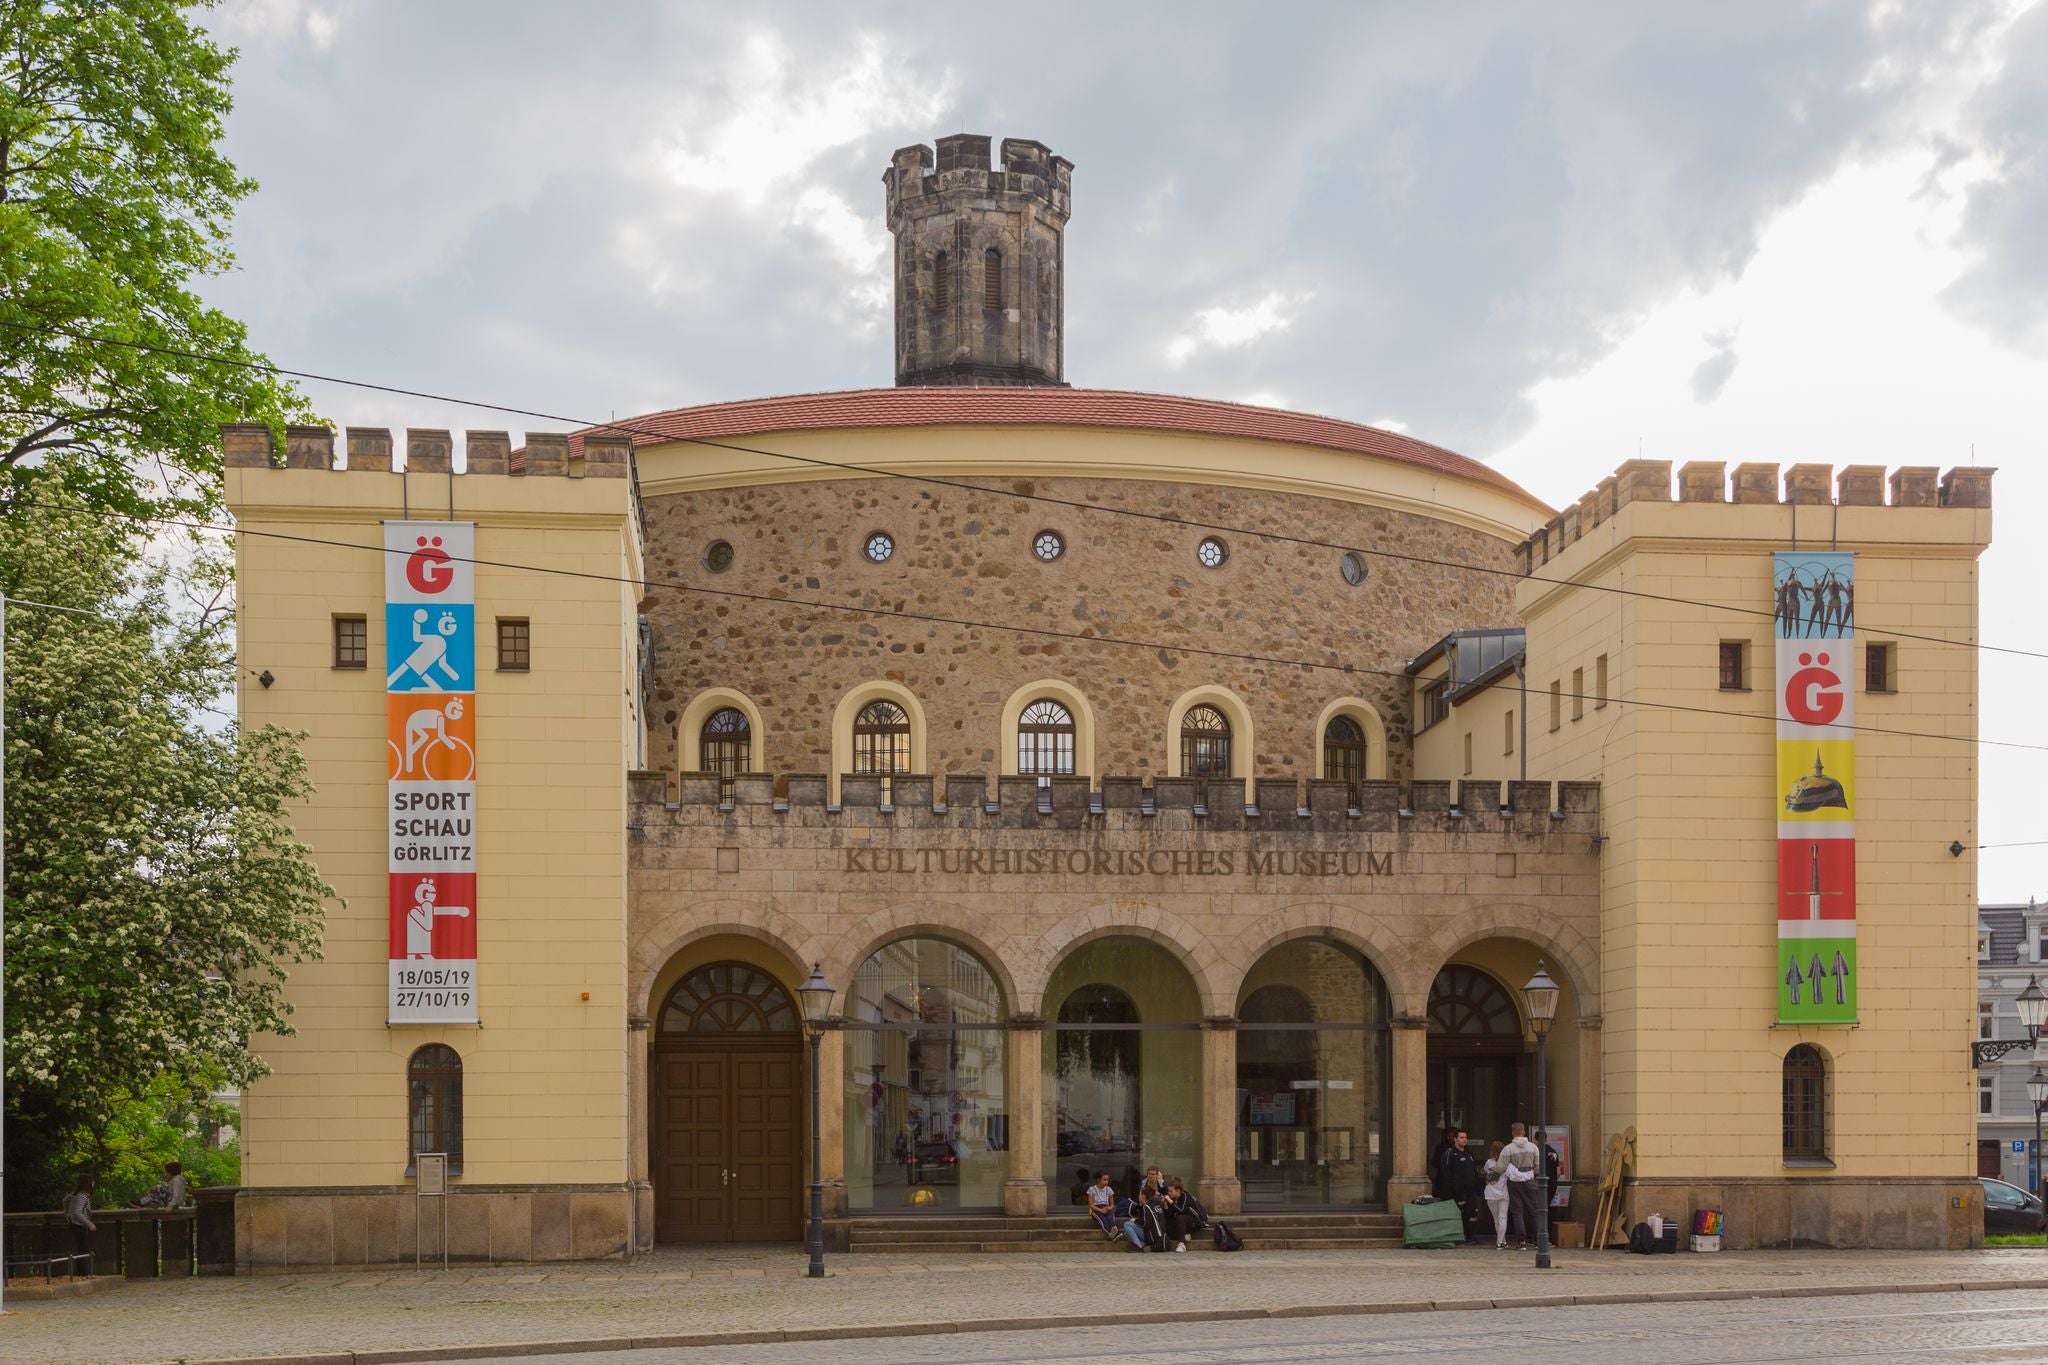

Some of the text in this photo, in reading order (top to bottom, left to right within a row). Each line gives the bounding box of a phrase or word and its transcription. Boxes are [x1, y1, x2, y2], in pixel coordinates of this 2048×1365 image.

[394, 792, 471, 811] SPORT
[394, 818, 471, 837] SCHAU
[394, 842, 472, 861] GÖRLITZ
[844, 847, 1395, 877] KULTURHISTORISCHES MUSEUM
[397, 969, 470, 986] 18/05/19
[397, 991, 470, 1008] 27/10/19
[2014, 1141, 2022, 1151] P
